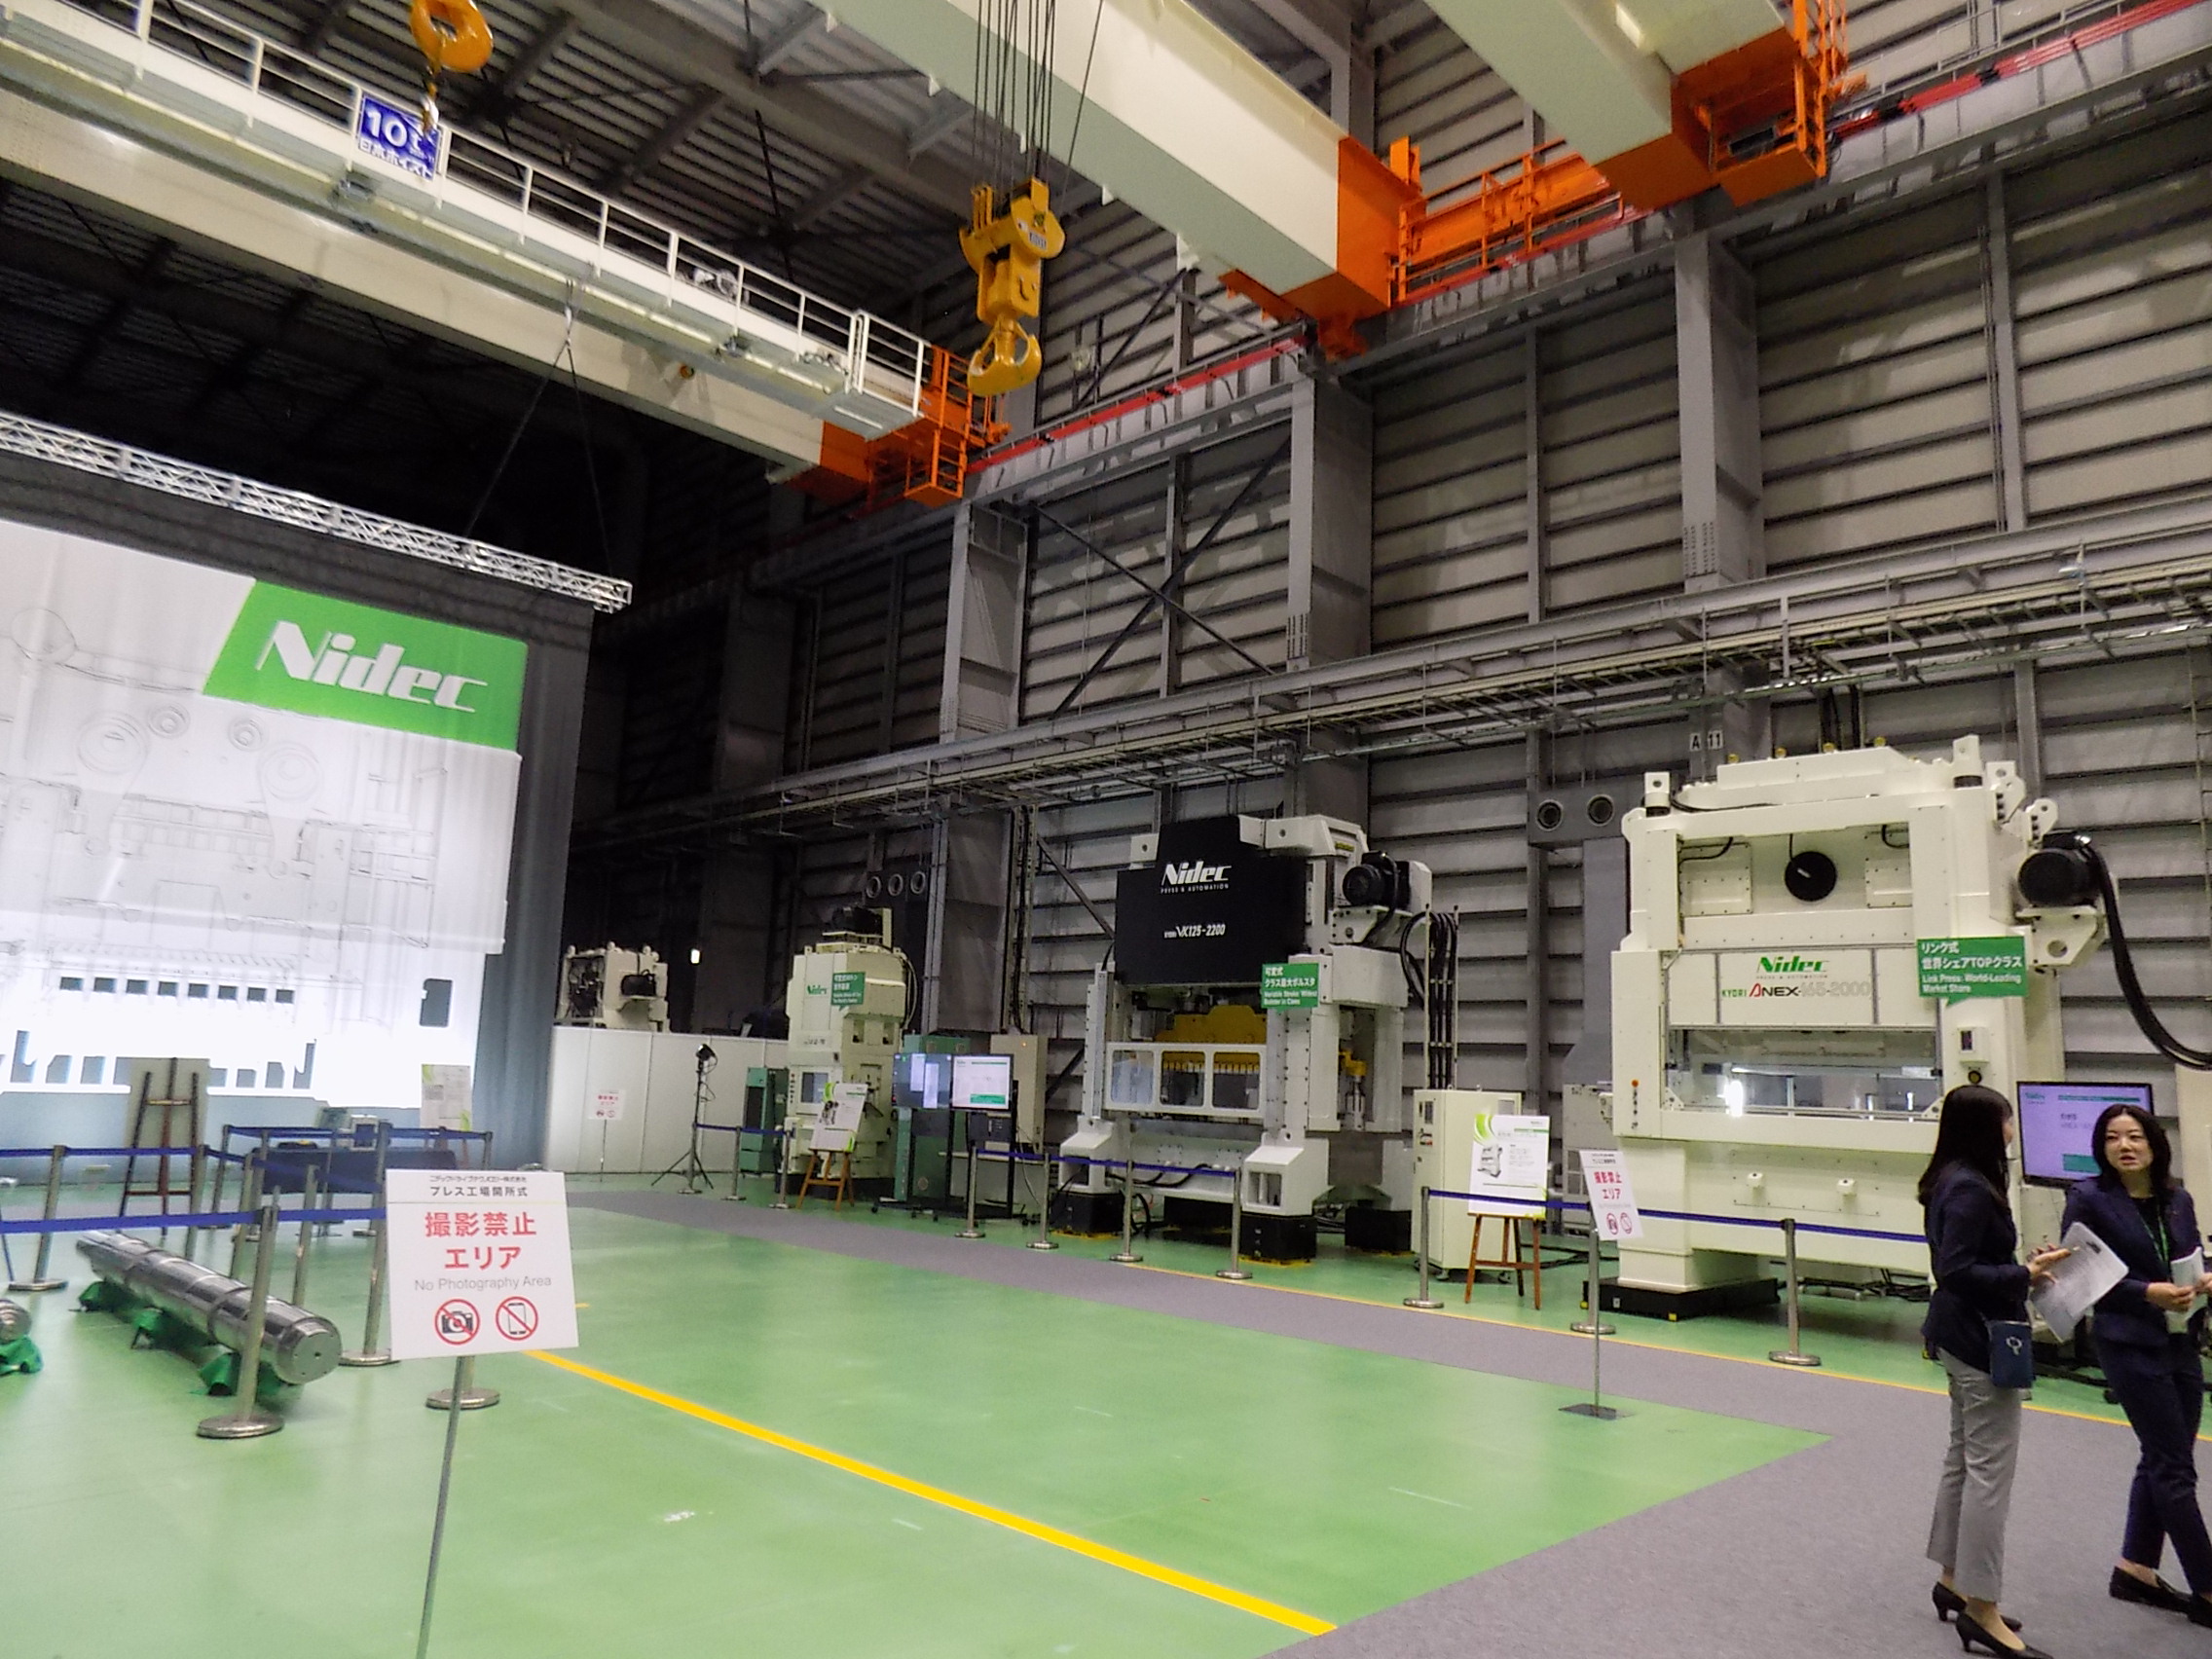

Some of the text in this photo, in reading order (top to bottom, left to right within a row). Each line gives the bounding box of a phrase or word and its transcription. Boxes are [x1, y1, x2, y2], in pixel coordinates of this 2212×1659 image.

[360, 138, 433, 179] 日本ホイスト
[255, 620, 488, 713] Nidec
[1709, 733, 1720, 747] 11
[1161, 861, 1232, 885] Nidec
[1922, 941, 1959, 954] リンク式
[1757, 956, 1830, 973] Nidec
[1922, 956, 2022, 970] 世界シェアTOPクラス
[424, 1211, 536, 1237] 撮影禁止
[445, 1246, 521, 1270] エリア
[415, 1275, 552, 1292] No Photography Area
